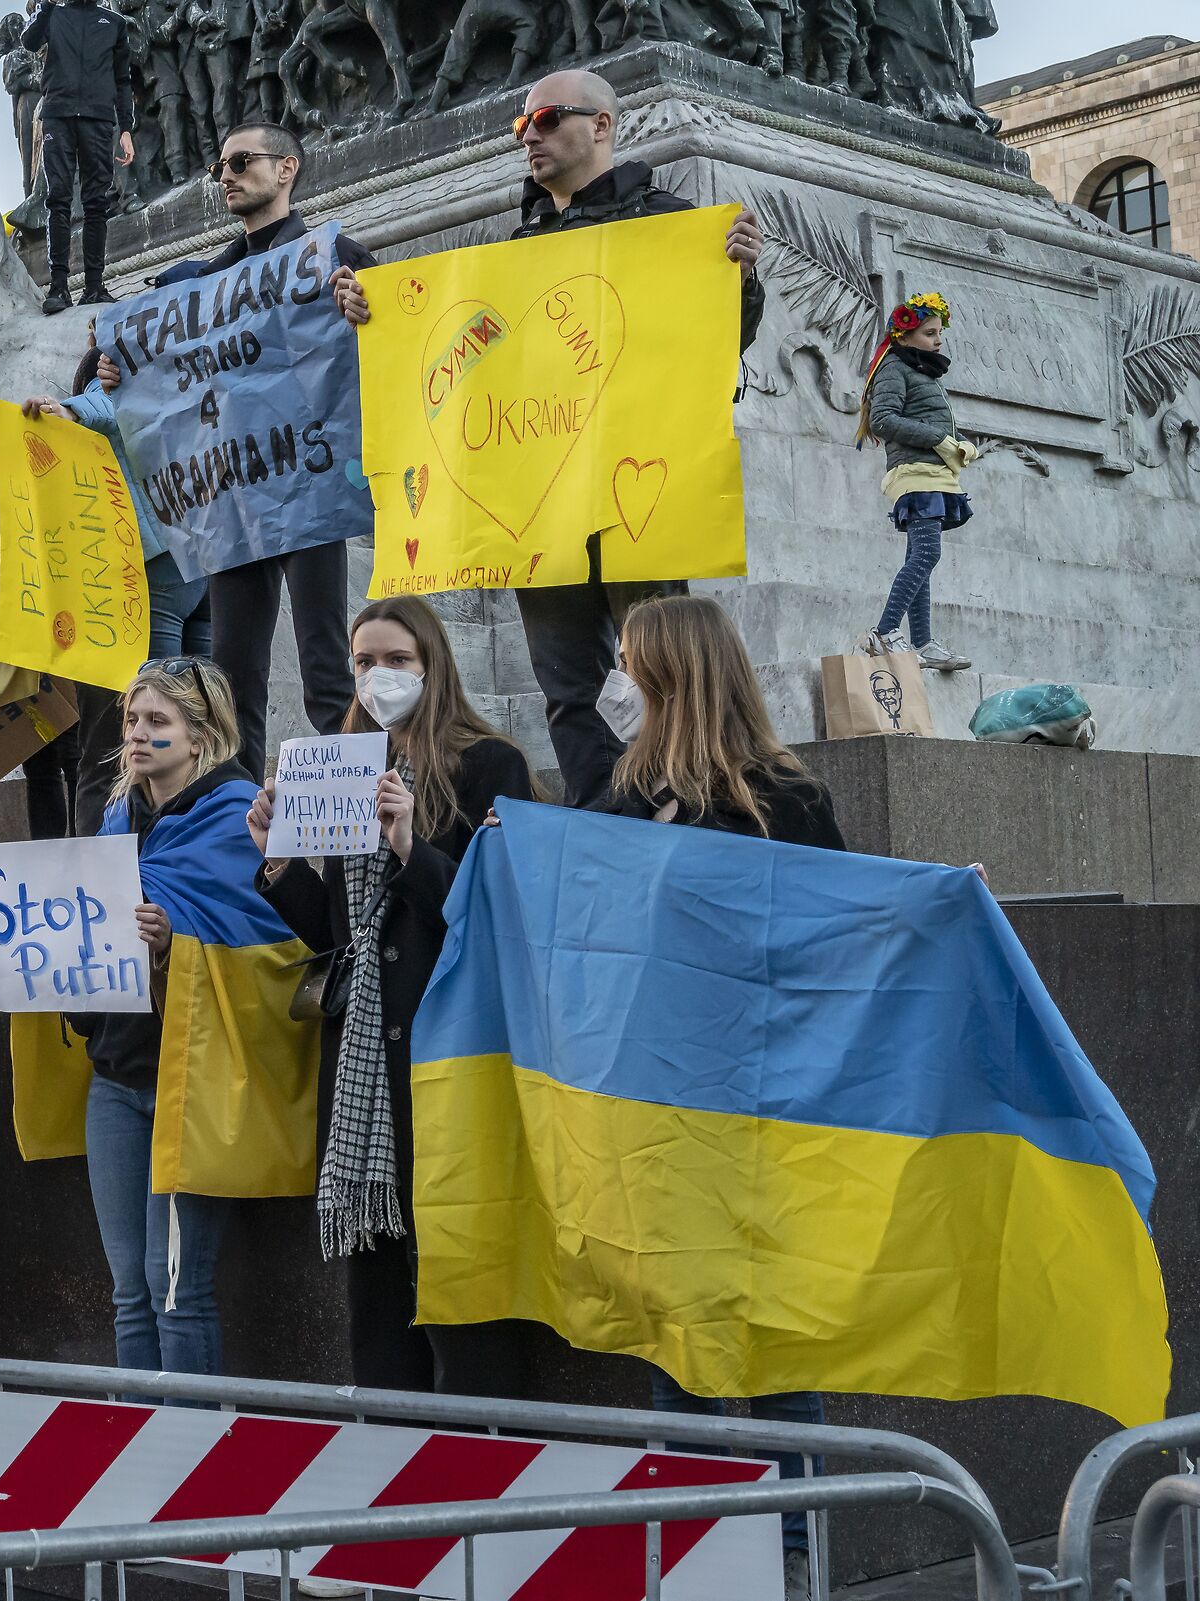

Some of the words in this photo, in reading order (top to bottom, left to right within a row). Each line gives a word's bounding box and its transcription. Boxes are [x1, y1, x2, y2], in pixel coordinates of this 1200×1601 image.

[113, 241, 322, 376] ITALIANS
[545, 290, 604, 376] SUMY
[174, 330, 262, 393] STAND
[427, 314, 503, 405] СУМИ
[200, 389, 220, 429] 4
[142, 420, 334, 527] UKRAINIANS
[9, 478, 45, 617] PEACE
[44, 526, 70, 583] FOR
[381, 578, 397, 597] NIE
[399, 574, 438, 593] CHCEMY
[446, 566, 512, 589] WOJNY
[278, 768, 324, 783] ВОЕННЫЙ
[331, 766, 377, 778] КОРАБЛЬ
[280, 742, 342, 768] РУССКИЙ
[284, 795, 326, 823] ИДИ
[11, 941, 144, 1000] Putin
